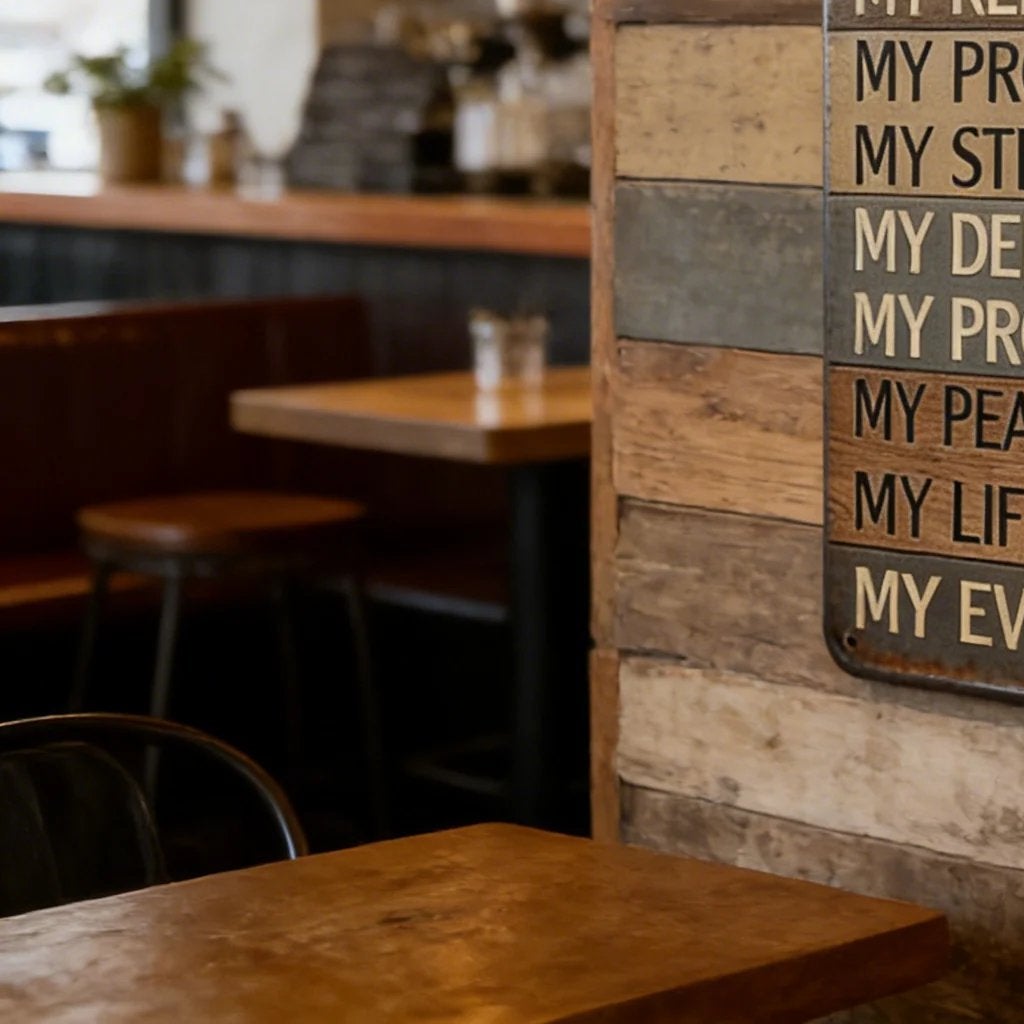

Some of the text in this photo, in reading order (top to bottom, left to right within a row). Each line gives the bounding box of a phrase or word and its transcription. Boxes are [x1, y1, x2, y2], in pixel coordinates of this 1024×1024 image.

[856, 40, 933, 102] MY
[855, 125, 934, 187] MY
[854, 208, 934, 274] MY
[854, 292, 934, 359] MY
[855, 379, 926, 443] MY
[855, 471, 932, 538] MY
[855, 566, 942, 638] MY
